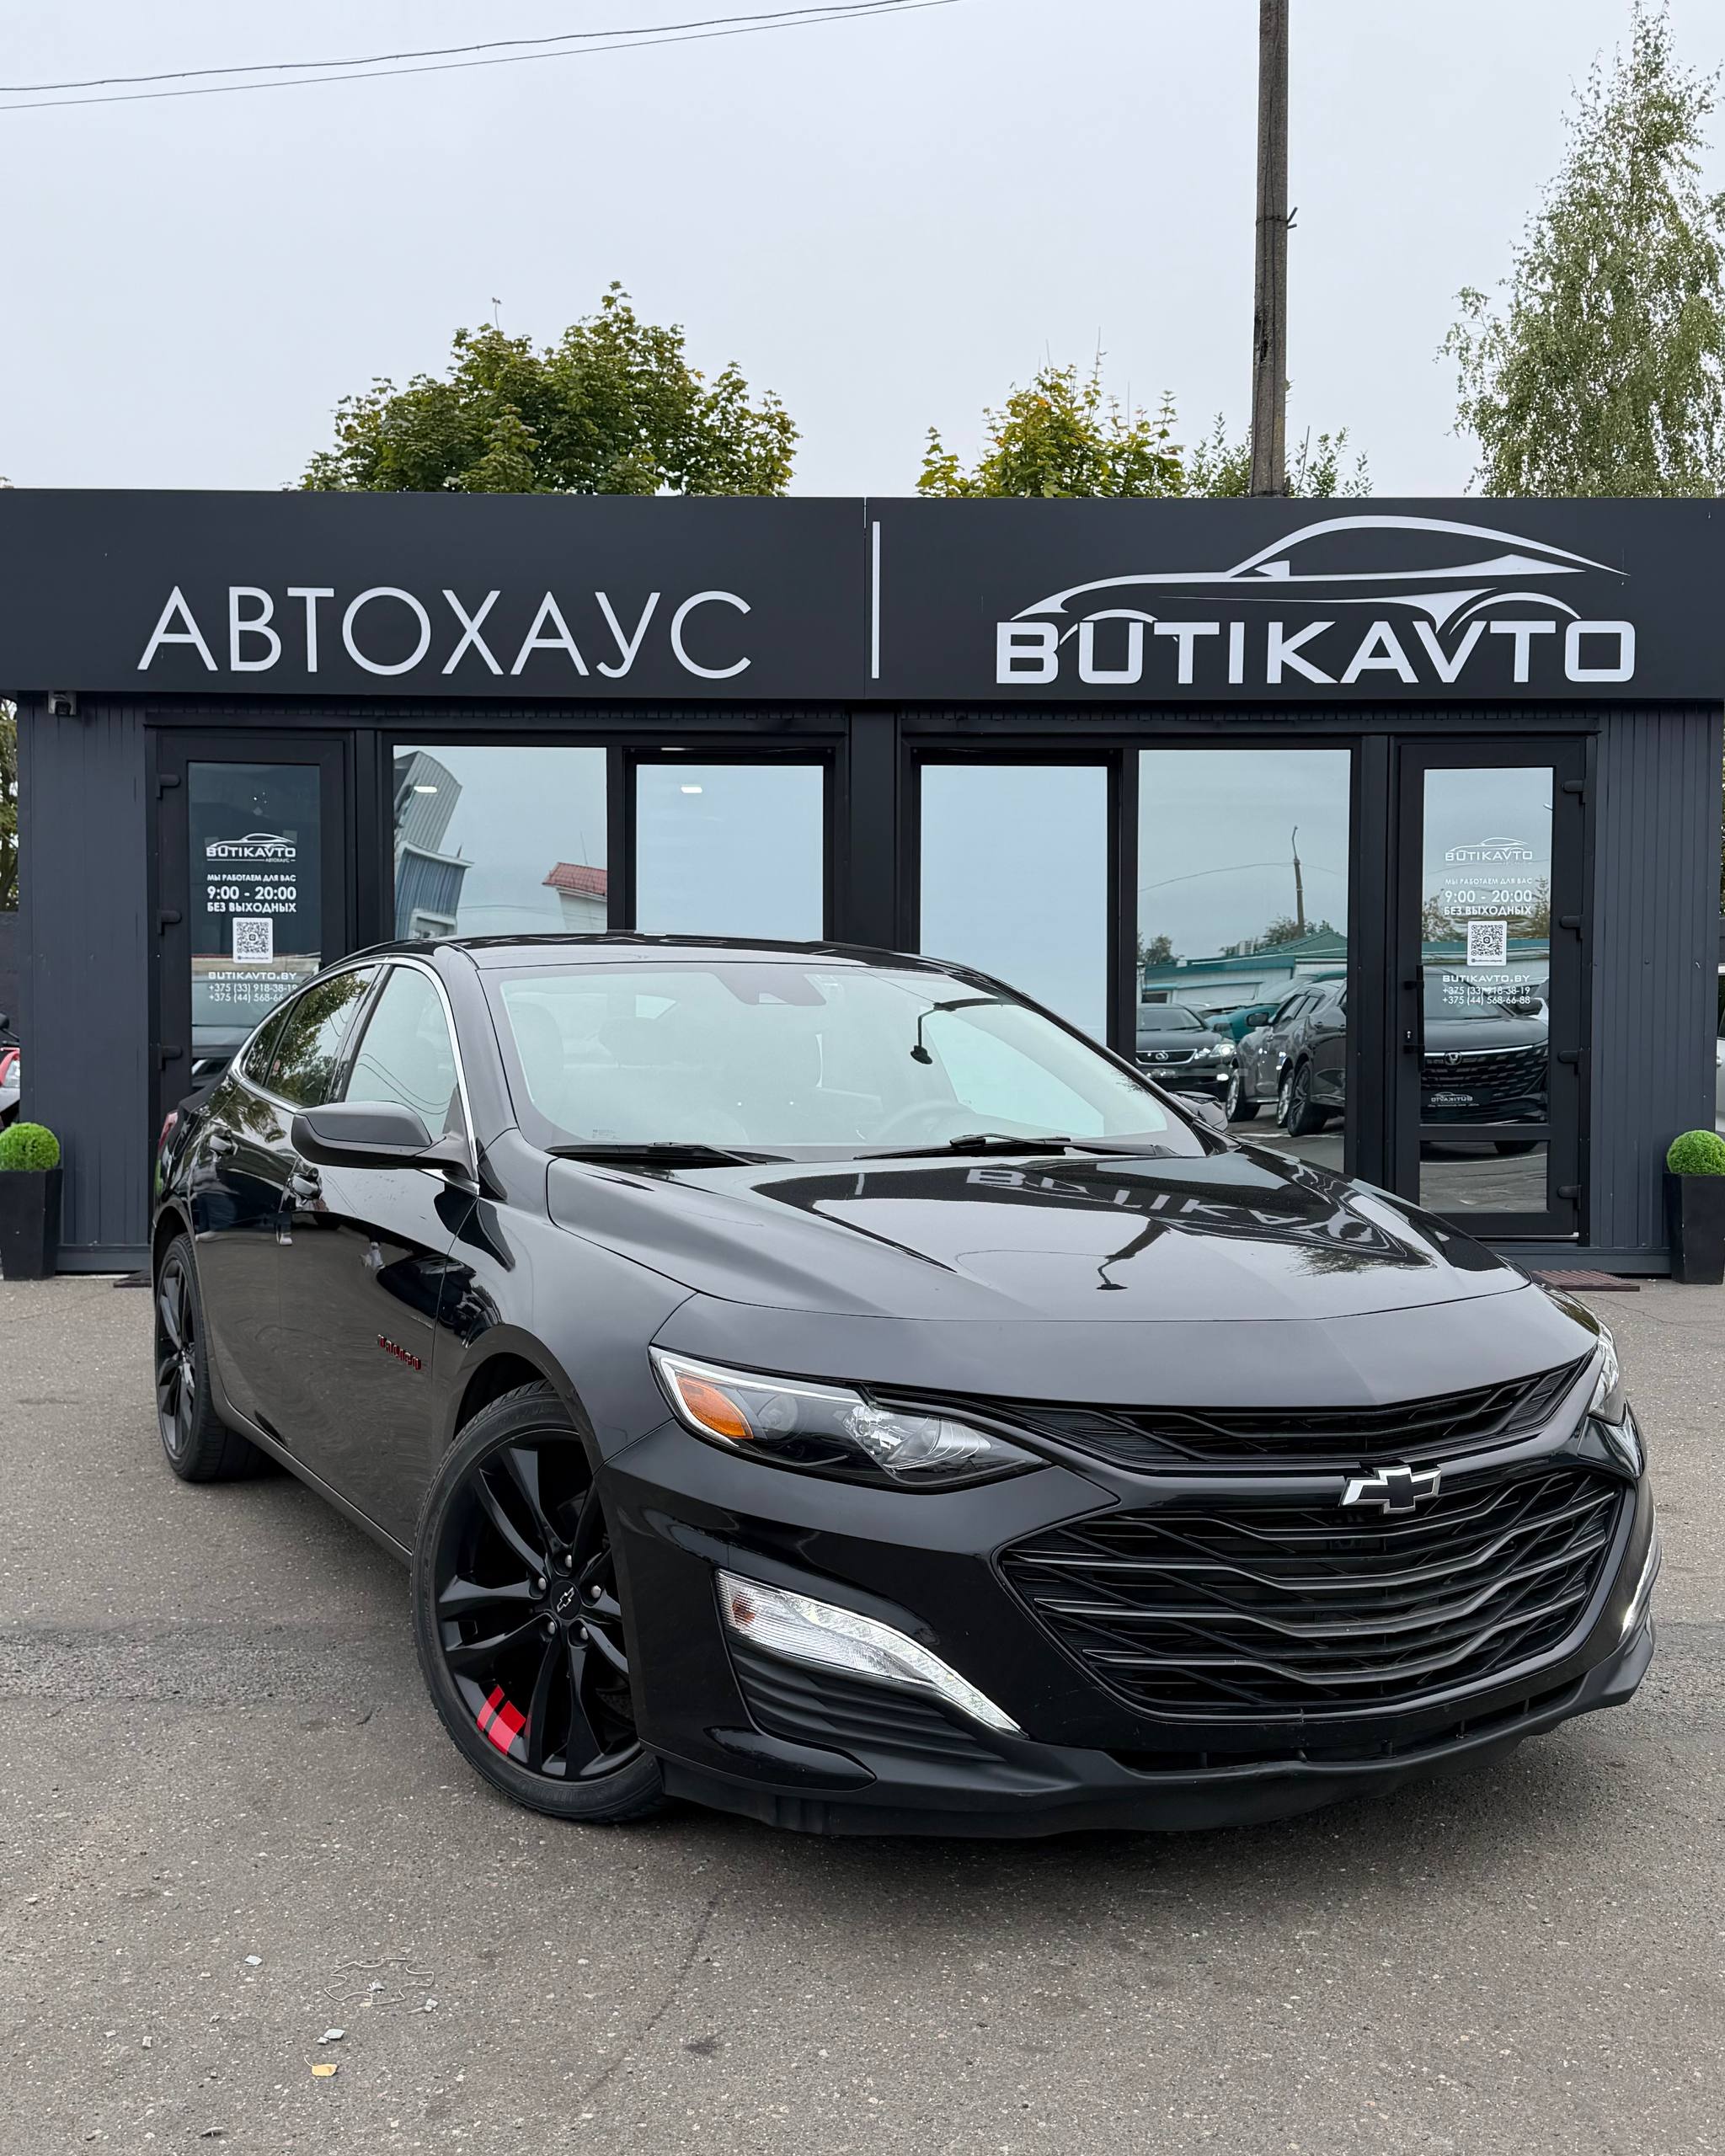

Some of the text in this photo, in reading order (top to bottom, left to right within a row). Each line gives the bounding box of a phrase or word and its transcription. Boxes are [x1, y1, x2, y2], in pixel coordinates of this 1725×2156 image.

[137, 585, 752, 680] АВТОХАУС
[996, 620, 1637, 685] BUTIKAVTO
[206, 846, 296, 857] BUTIKAVTO
[1445, 851, 1533, 861] BUTIKAVTO
[207, 886, 240, 899] 9:00
[254, 886, 296, 899] 20:00
[1445, 890, 1476, 903] 9:00
[1492, 889, 1532, 903] 20:00
[207, 902, 296, 914] БЕЗ ВЫХОДНЫХ
[1444, 905, 1532, 916] БЕЗ ВЫХОДНЫХ
[208, 971, 297, 980] BUTIKAVTO.BY
[1442, 974, 1530, 983] BUTIKAVTO.BY
[209, 983, 231, 992] +375
[234, 983, 251, 993] (33)
[1442, 986, 1465, 995] +375
[1467, 986, 1483, 996] (33)
[209, 993, 231, 1002] +375
[234, 993, 251, 1003] (44)
[1442, 995, 1530, 1006] +375 (44) 568-66-88
